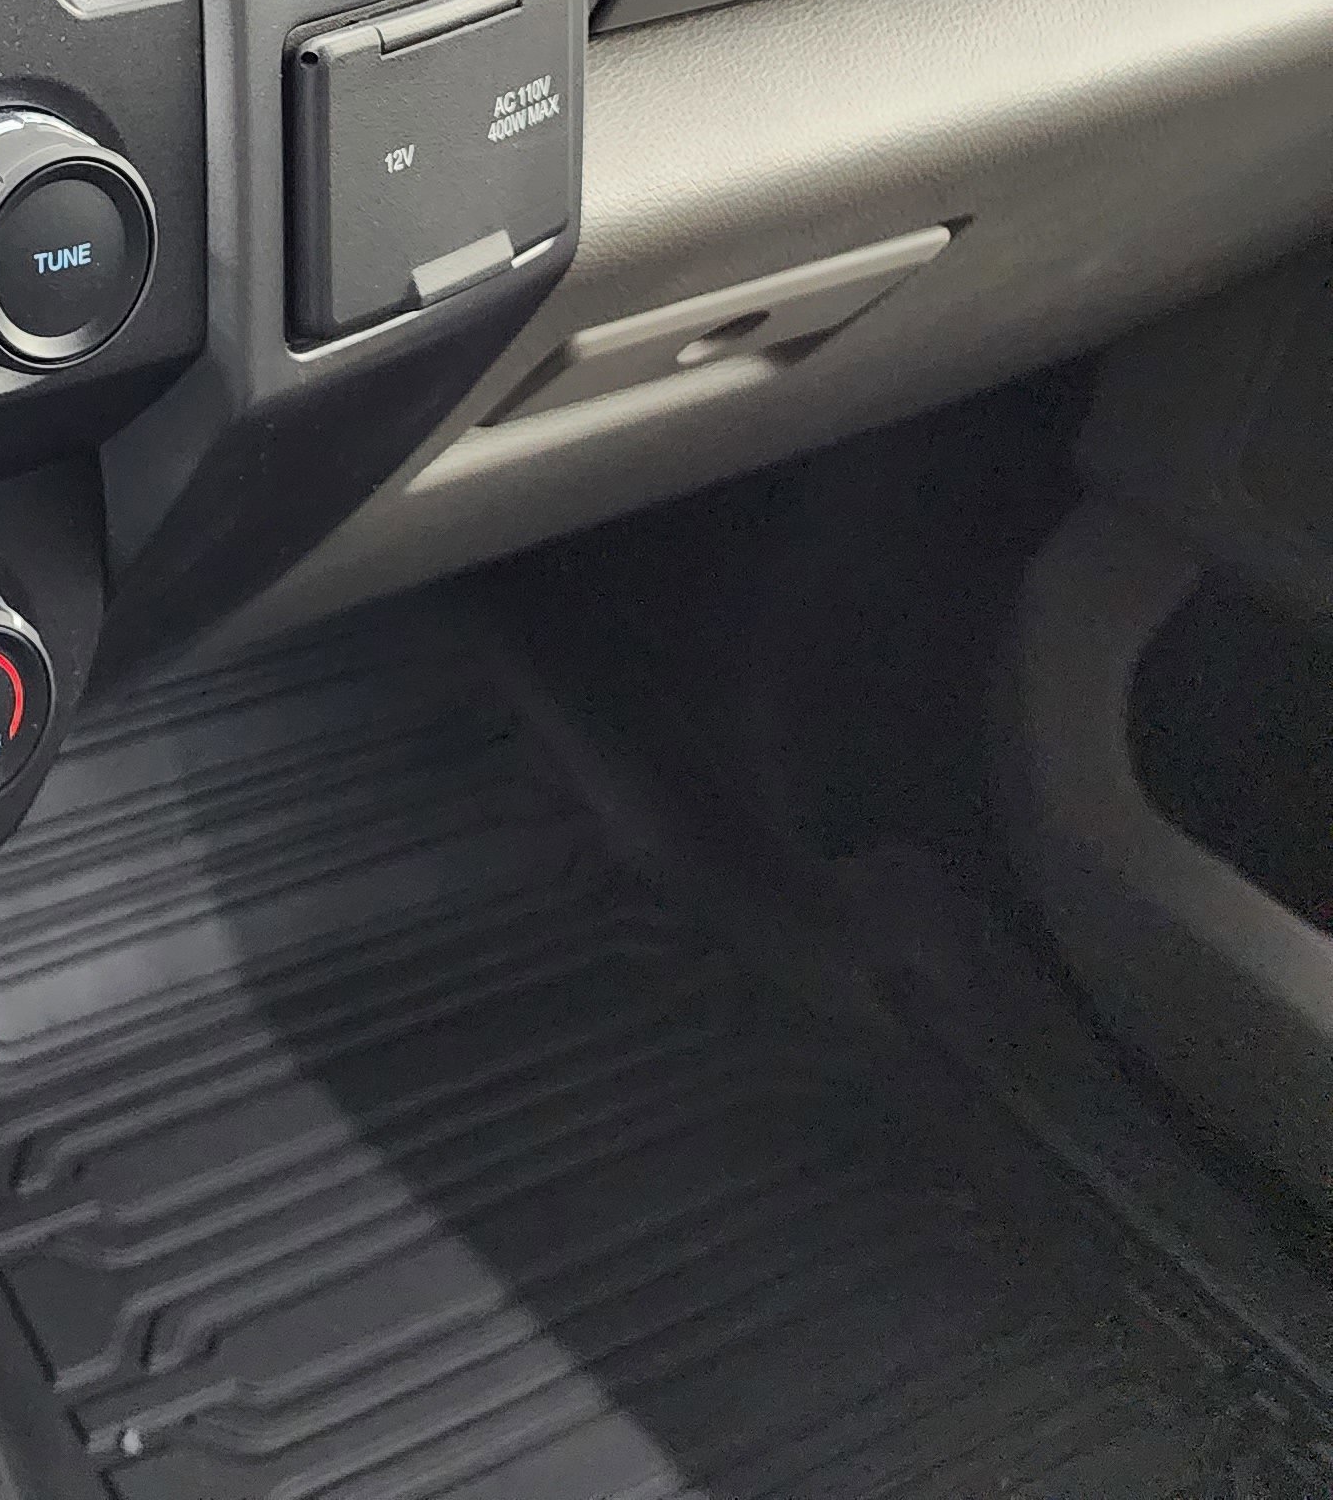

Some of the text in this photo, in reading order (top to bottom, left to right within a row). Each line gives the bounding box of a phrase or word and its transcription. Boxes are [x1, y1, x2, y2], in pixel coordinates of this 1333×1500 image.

[493, 75, 552, 117] AC 110V
[487, 94, 560, 143] 400W MAX
[384, 145, 415, 173] 12V
[33, 242, 92, 274] TUNE
